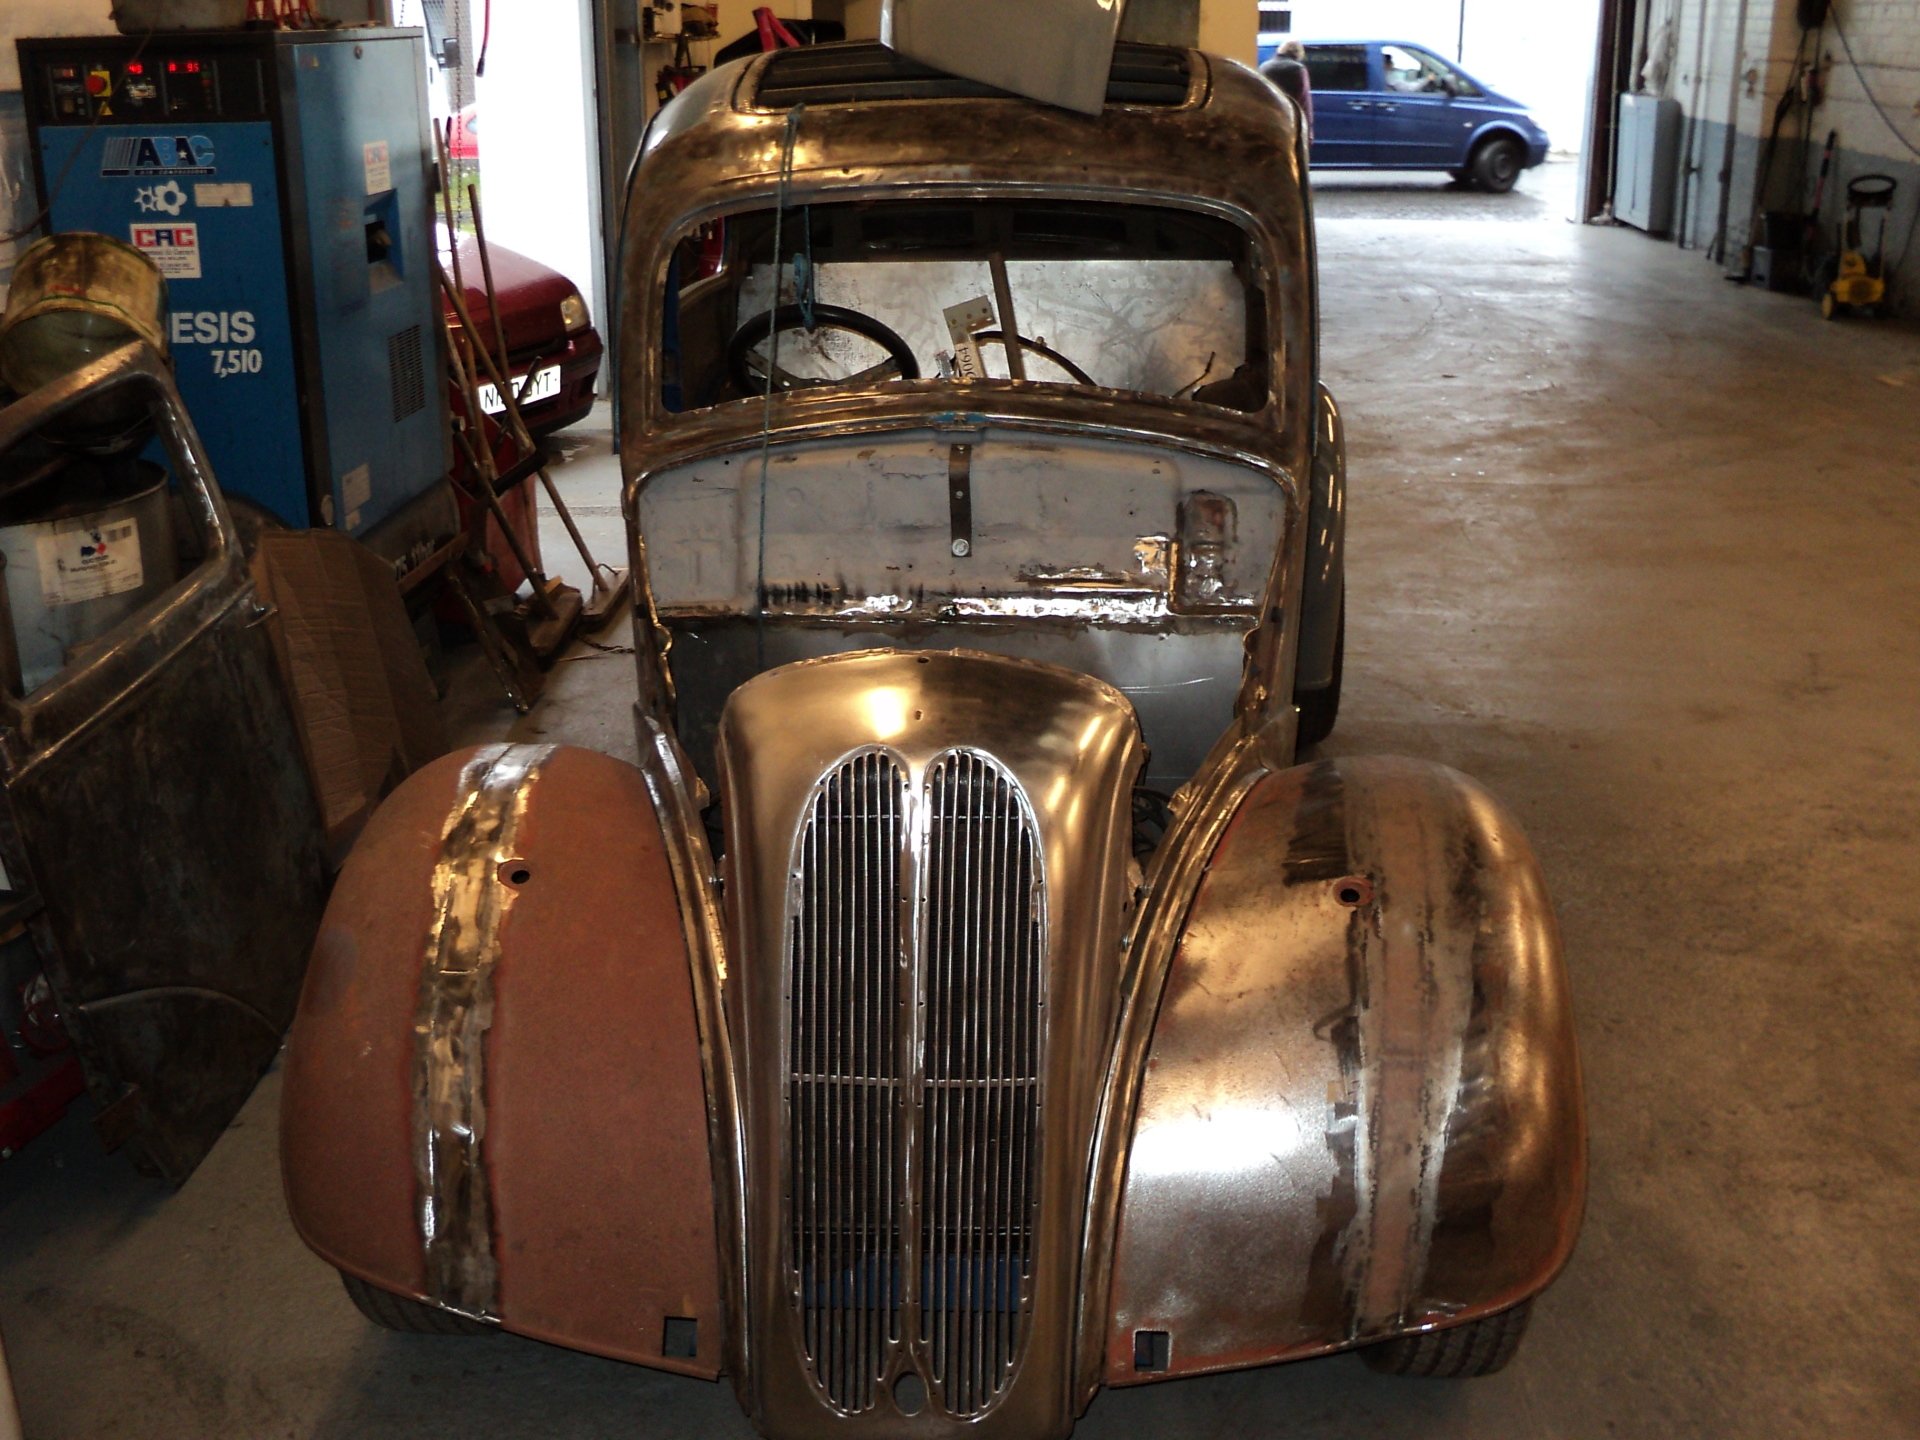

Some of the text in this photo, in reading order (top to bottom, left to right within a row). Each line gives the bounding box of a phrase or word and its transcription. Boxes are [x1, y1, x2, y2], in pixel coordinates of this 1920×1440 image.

[137, 135, 215, 167] ABAC
[135, 228, 195, 248] CAC
[167, 311, 256, 344] ESIS
[211, 349, 262, 378] 7,510
